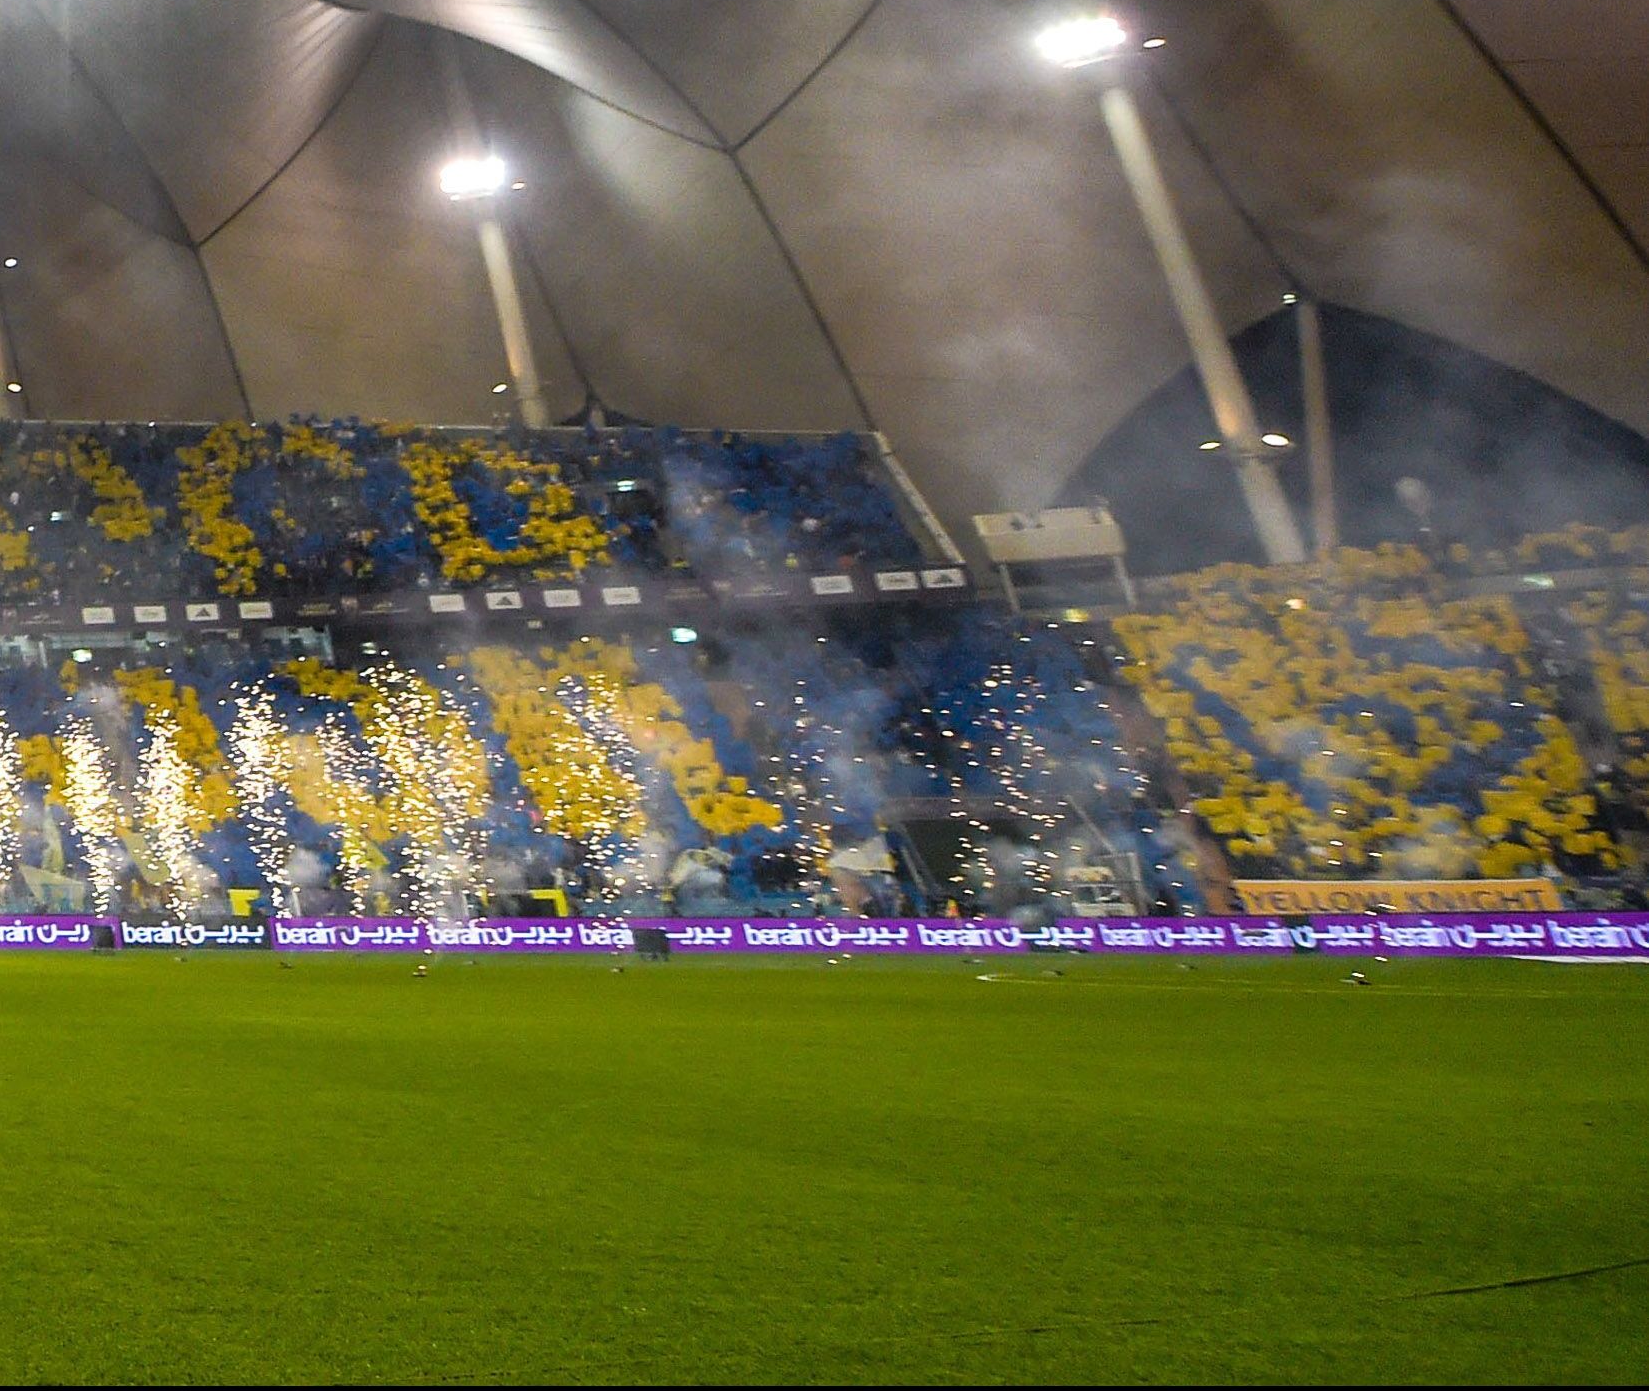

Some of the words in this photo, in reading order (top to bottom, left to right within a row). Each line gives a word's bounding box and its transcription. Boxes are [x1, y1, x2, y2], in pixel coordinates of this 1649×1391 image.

[123, 920, 182, 944] berain
[184, 921, 264, 945] بيرين
[276, 920, 336, 945] berain
[339, 922, 419, 947] بيرين
[580, 922, 634, 946] berai
[744, 922, 813, 946] berain
[814, 923, 909, 947] بيرين
[917, 922, 994, 946] berain
